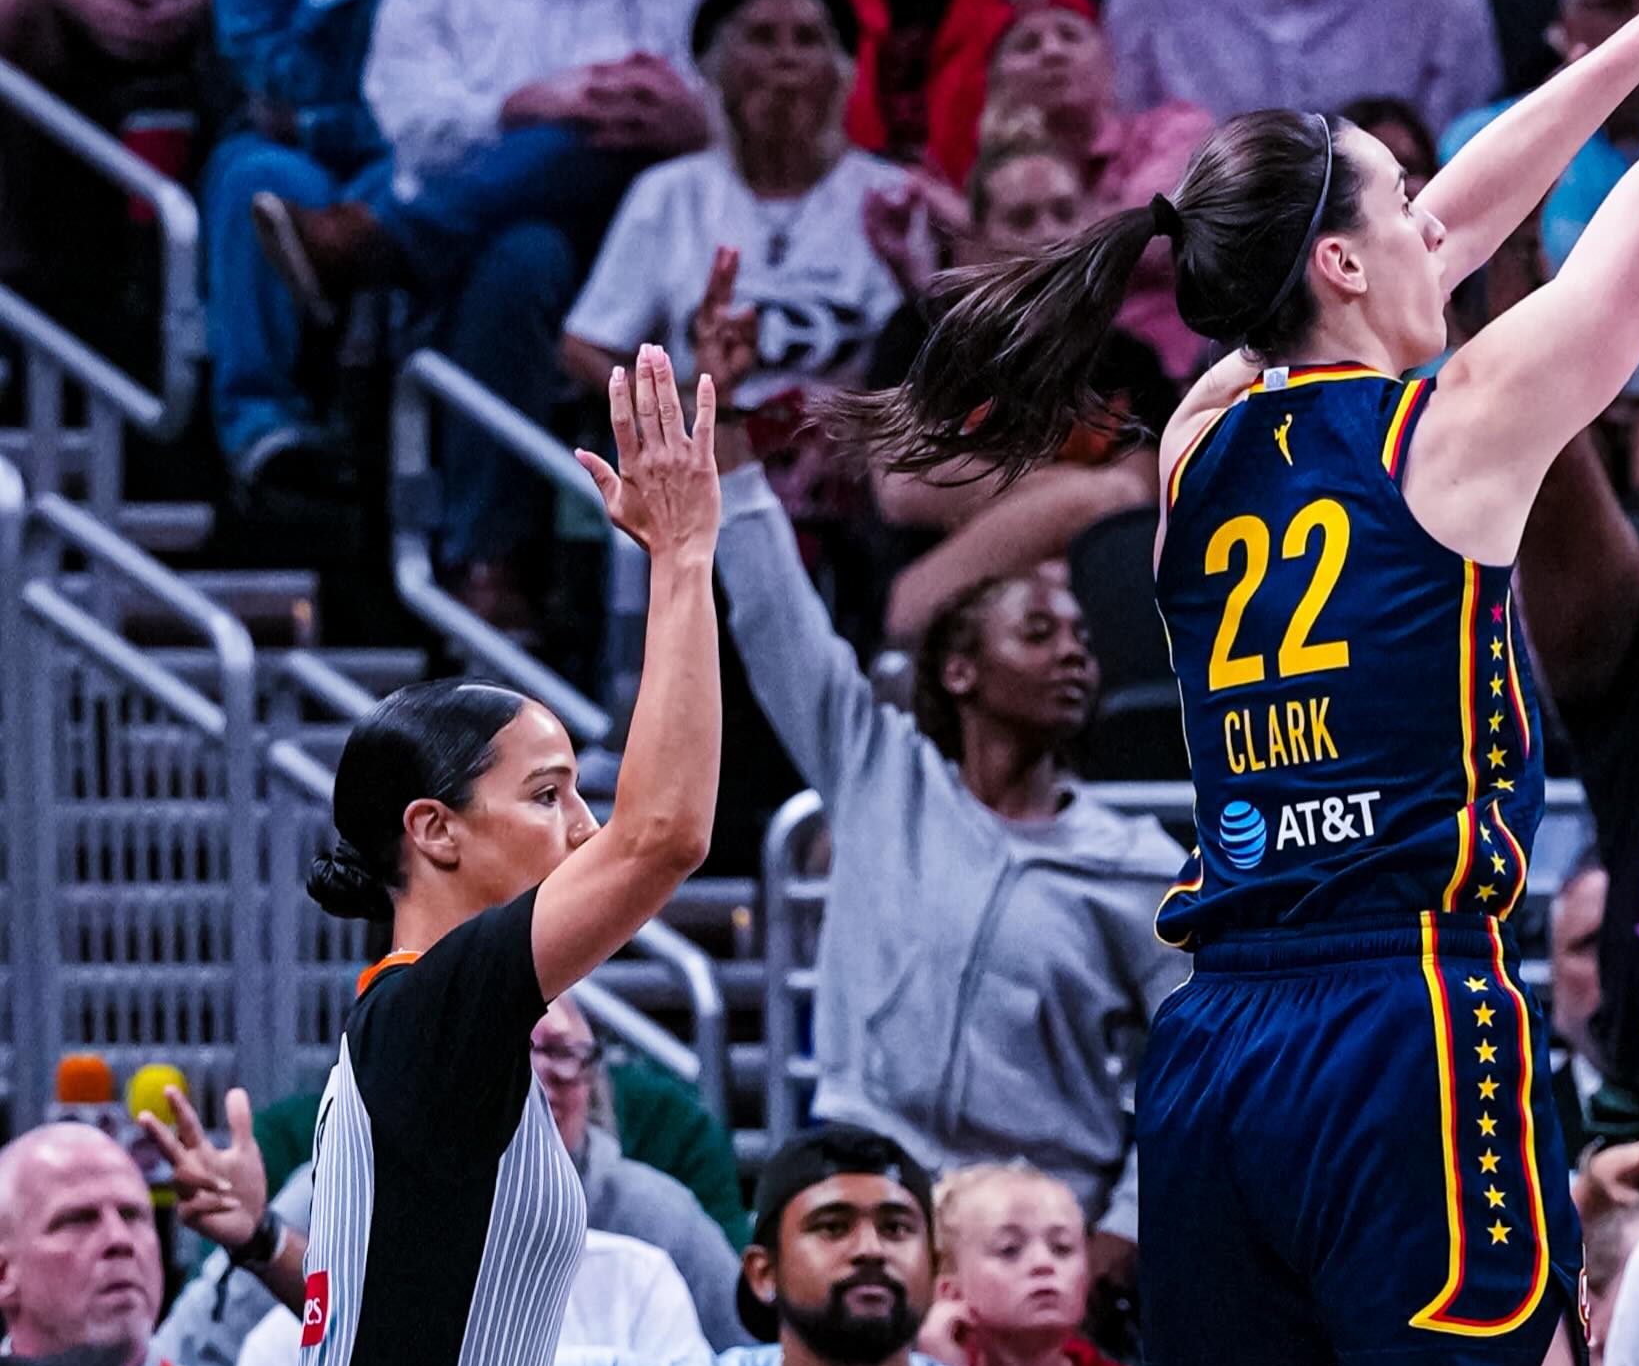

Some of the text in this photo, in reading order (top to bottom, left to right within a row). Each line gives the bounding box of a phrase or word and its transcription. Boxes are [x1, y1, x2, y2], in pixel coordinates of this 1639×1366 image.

[1204, 497, 1351, 692] 22
[1223, 696, 1339, 775] CLARK
[1276, 790, 1382, 852] AT&T
